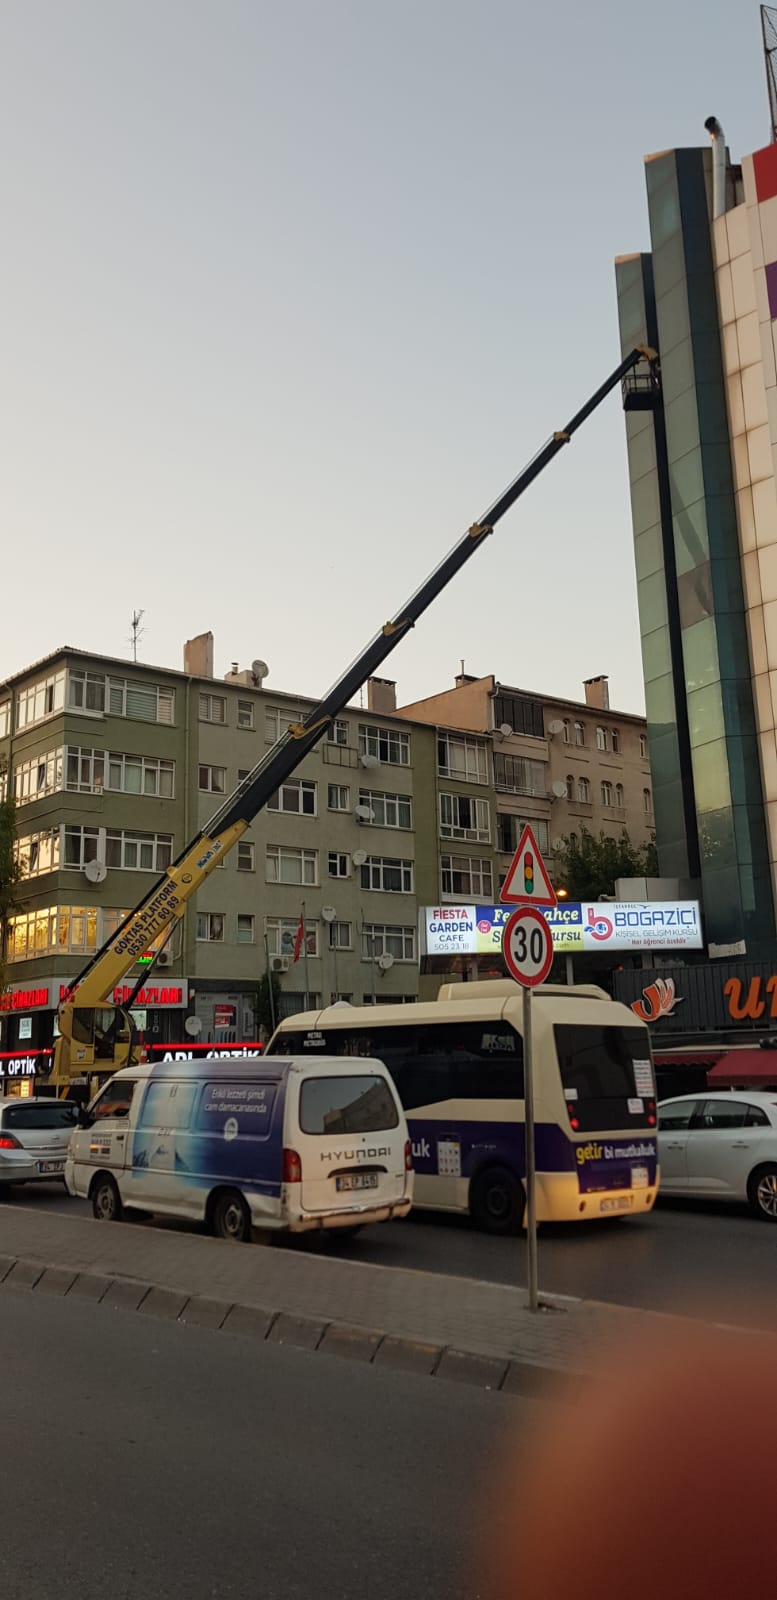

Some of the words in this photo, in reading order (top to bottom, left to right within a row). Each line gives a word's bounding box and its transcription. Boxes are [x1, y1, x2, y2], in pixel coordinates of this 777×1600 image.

[140, 880, 178, 923] PLATFORM
[493, 907, 579, 924] Feahçe
[127, 934, 147, 956] 0530
[144, 918, 160, 935] 777
[157, 907, 170, 920] 60
[167, 896, 179, 909] 89
[429, 922, 473, 933] GARDEN
[439, 934, 464, 942] CAFE
[550, 930, 582, 941] ursu
[434, 943, 449, 951] 505
[514, 926, 543, 964] 30
[8, 1056, 36, 1076] OPTİK
[320, 1147, 391, 1161] HYUNDAI
[411, 1138, 430, 1157] uk
[576, 1142, 603, 1165] getir
